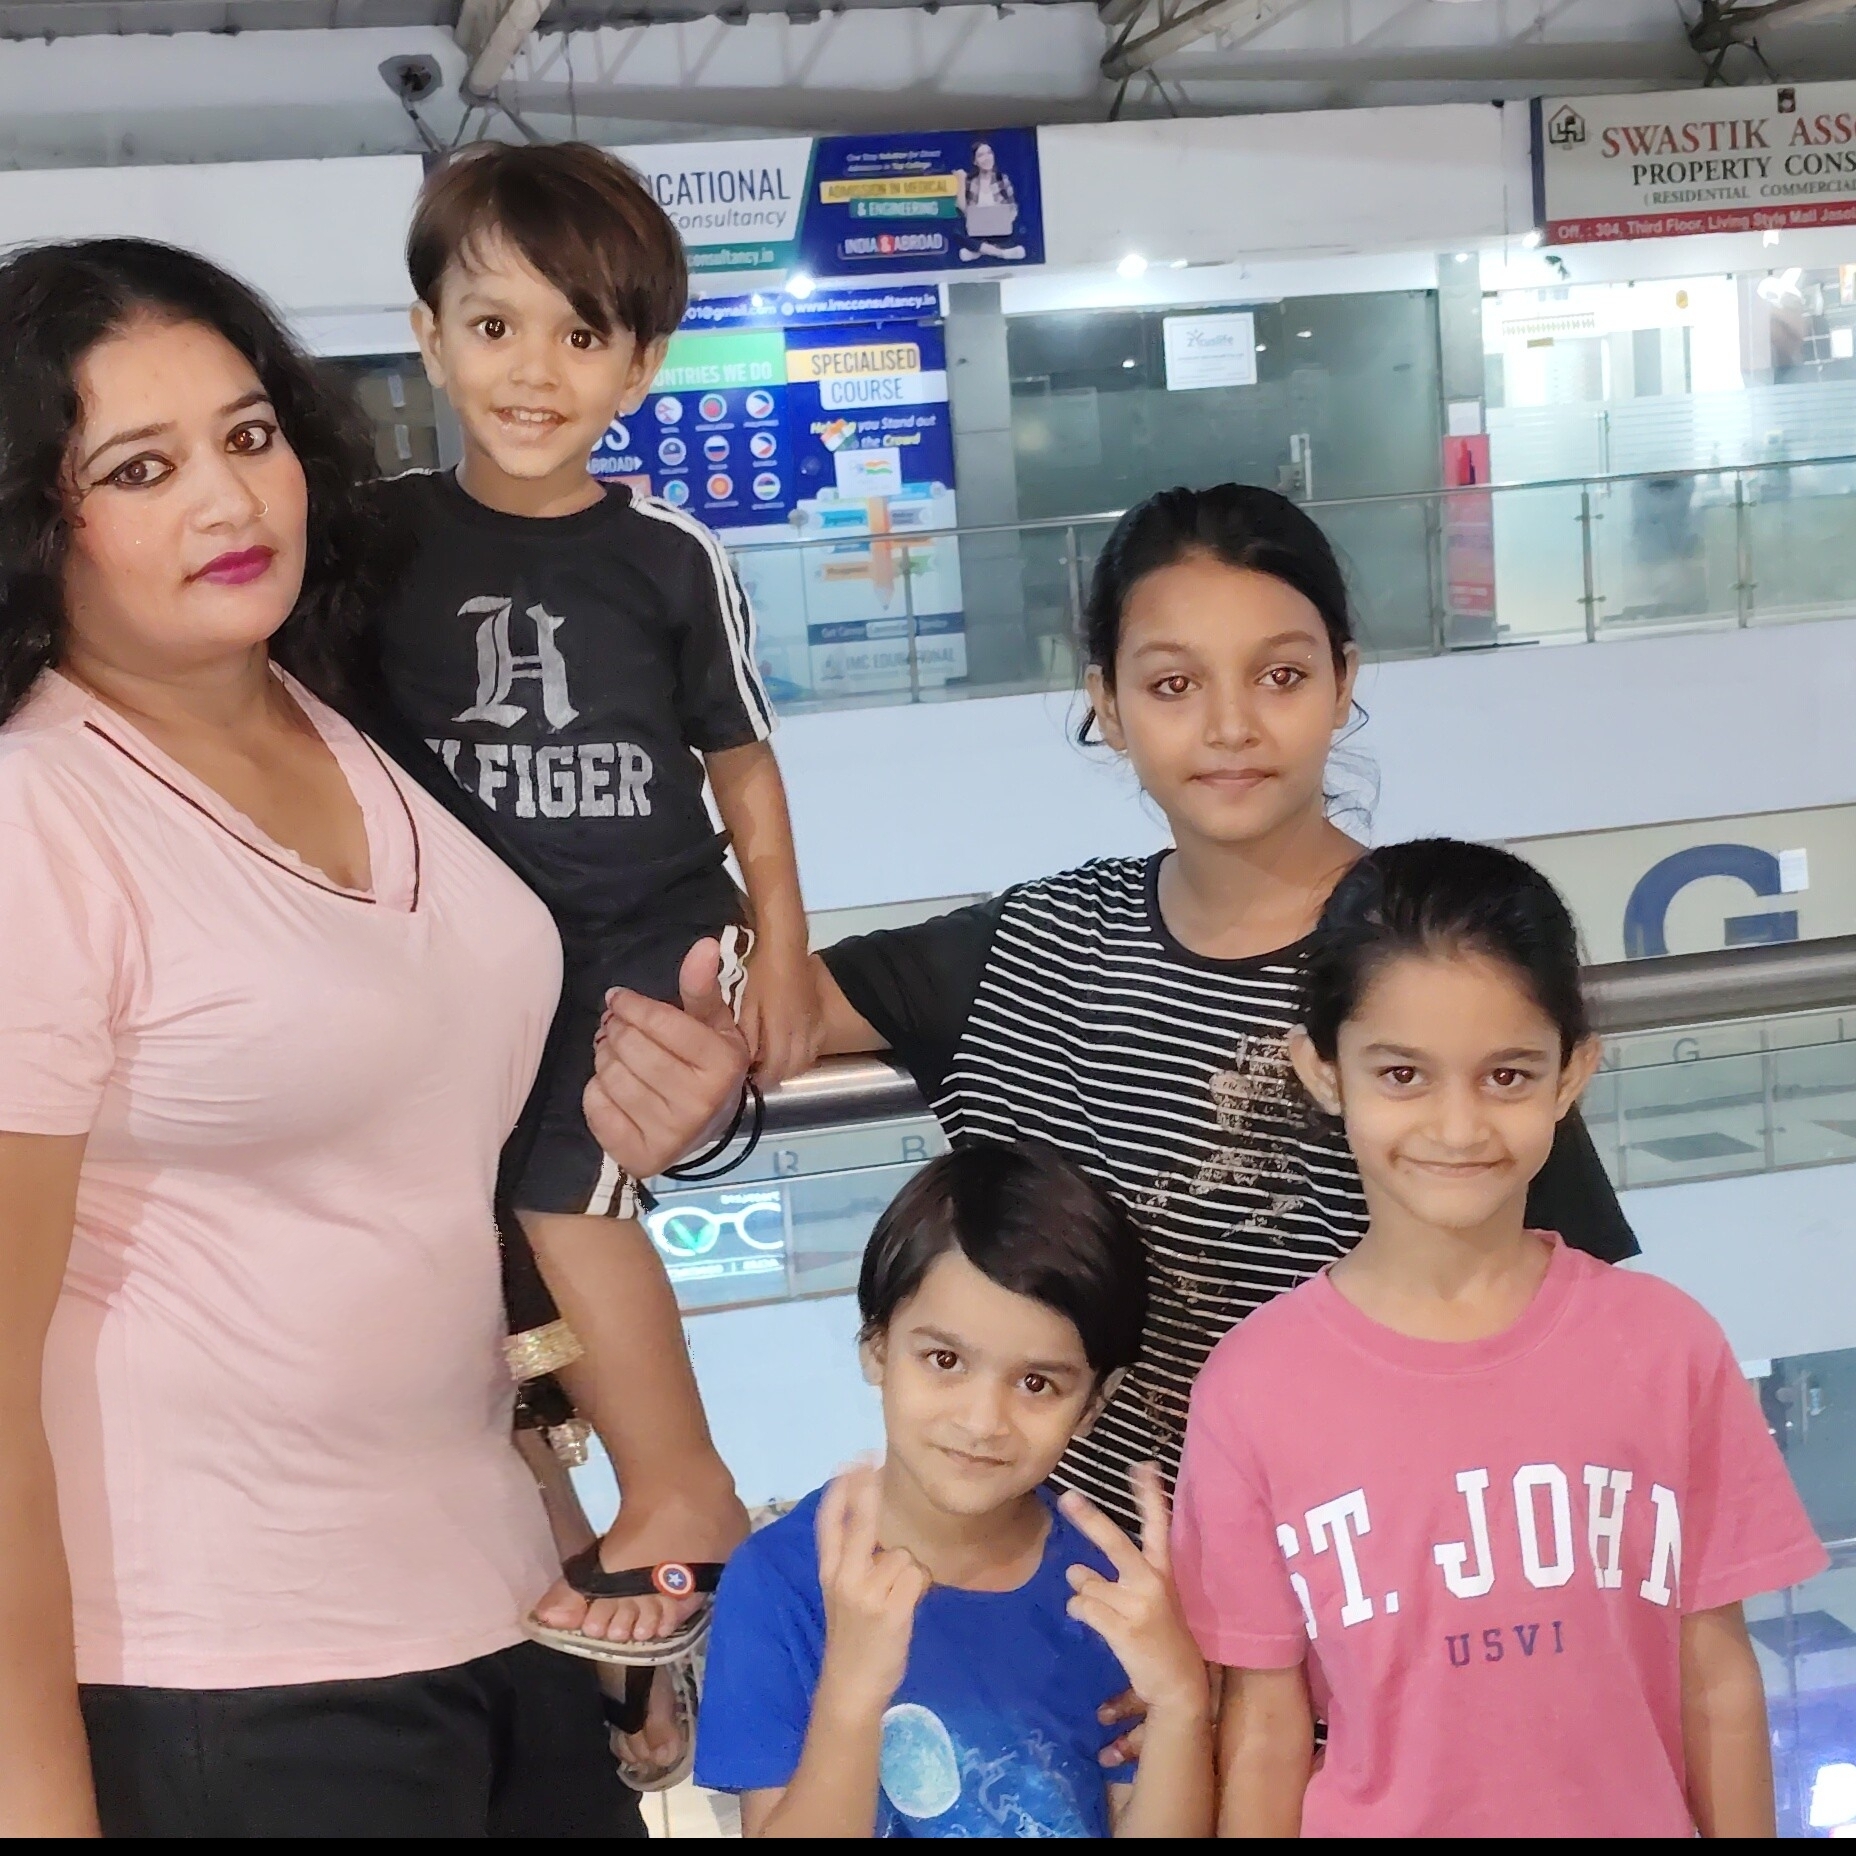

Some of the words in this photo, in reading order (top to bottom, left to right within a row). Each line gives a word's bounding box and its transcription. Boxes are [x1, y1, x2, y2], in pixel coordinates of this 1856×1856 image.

[1601, 118, 1771, 158] SWASTIK
[1788, 112, 1856, 147] ASS
[1632, 156, 1772, 186] PROPERTY
[828, 184, 887, 198] ADMISSION
[889, 183, 901, 194] IN
[903, 180, 949, 194] MEDICAL
[1652, 186, 1750, 204] RESIDENTIAL
[857, 202, 867, 217] &
[1627, 219, 1663, 234] Third
[1707, 215, 1750, 230] Living
[1752, 211, 1787, 229] Style
[844, 238, 877, 254] INDIA
[880, 236, 892, 253] &
[893, 233, 943, 250] ABROAD
[723, 364, 747, 382] WE
[749, 361, 773, 380] DO
[811, 348, 917, 376] SPECIALISED
[831, 378, 905, 404] COURSE
[588, 419, 631, 452] S
[451, 595, 580, 734] H
[424, 738, 653, 818] FIGER
[1623, 843, 1800, 960] G
[1672, 1037, 1701, 1063] G
[901, 1135, 927, 1162] B
[1444, 1620, 1564, 1668] USVI
